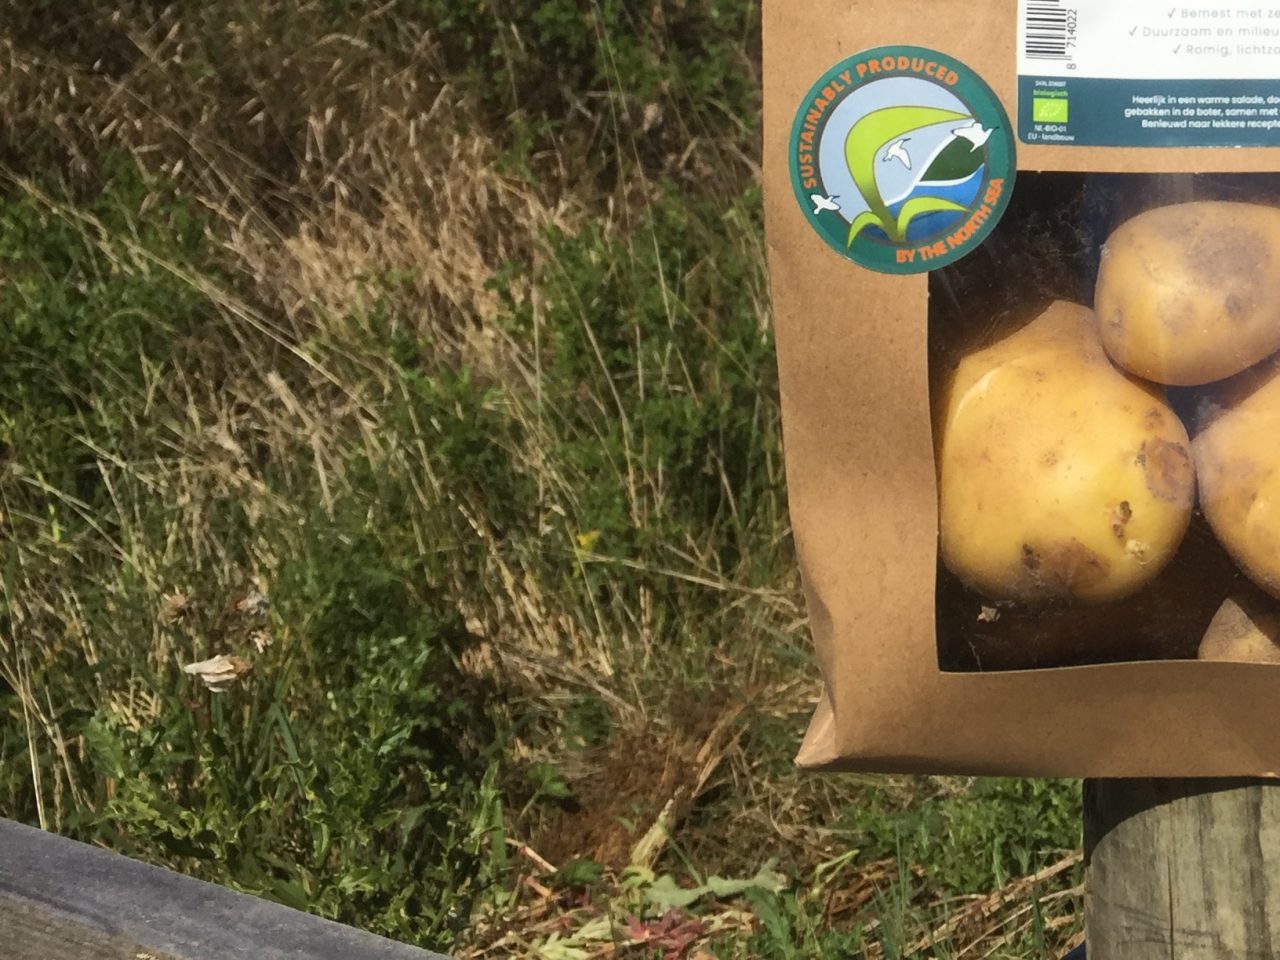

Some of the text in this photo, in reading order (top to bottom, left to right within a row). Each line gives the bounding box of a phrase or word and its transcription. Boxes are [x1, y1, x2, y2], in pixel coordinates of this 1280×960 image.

[1181, 8, 1231, 18] Bemest
[1236, 8, 1262, 18] met
[1066, 9, 1077, 48] 714022
[1143, 26, 1212, 37] Duurzaam
[1216, 28, 1233, 37] en
[1186, 44, 1232, 57] Romig,
[1132, 95, 1166, 106] Heerlijk
[1167, 95, 1176, 104] in
[1178, 96, 1196, 104] een
[1197, 96, 1230, 104] warme
[1231, 95, 1265, 105] salade,
[1124, 107, 1171, 117] gebakken
[1172, 107, 1181, 116] in
[1182, 107, 1195, 116] de
[1197, 107, 1224, 117] boter,
[1225, 108, 1257, 116] samen
[1259, 108, 1278, 116] met
[799, 55, 959, 189] SUSTAINABLY PRODUCED
[1141, 119, 1187, 128] Benieuwd
[1188, 120, 1210, 128] naar
[1212, 119, 1246, 128] lekkere
[896, 178, 1004, 263] BY THE NORTH SEA
